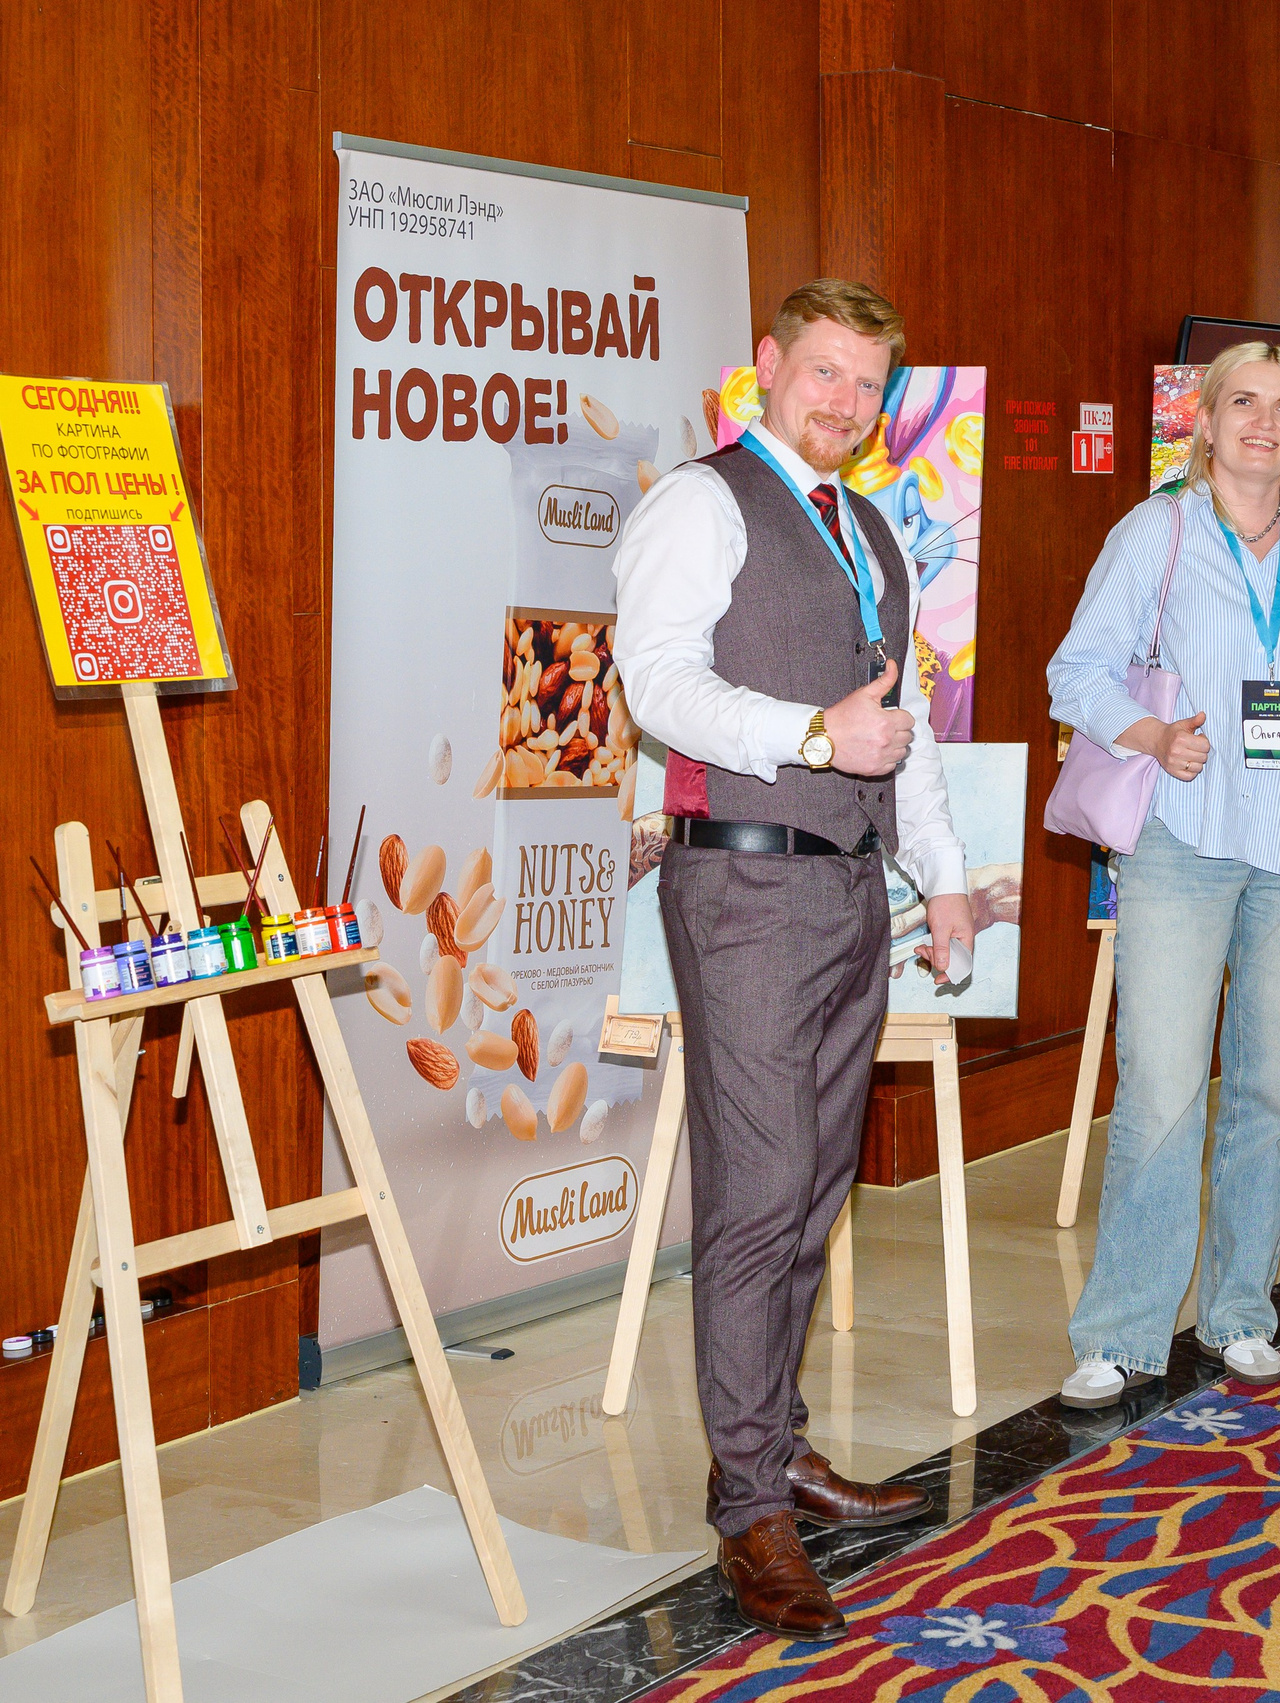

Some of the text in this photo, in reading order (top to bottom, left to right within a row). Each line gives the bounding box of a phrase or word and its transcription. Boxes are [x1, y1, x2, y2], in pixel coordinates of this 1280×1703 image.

[348, 178, 504, 223] ЗАО «Мюсли Лэнд»
[348, 205, 475, 240] УНП 192958741
[353, 266, 660, 361] ОТКРЫВАЙ
[21, 384, 141, 417] СЕГОДНЯ!!!
[352, 367, 568, 445] НОВОЕ!
[1006, 400, 1057, 416] ПРИ ПОЖАРЕ
[56, 422, 121, 439] КАРТИНА
[1013, 419, 1049, 434] ЗВОНИТЬ
[1083, 410, 1112, 426] ПК-22
[32, 443, 150, 462] ПО ФОТОГРАФИИ
[1024, 438, 1038, 452] 101
[1004, 456, 1058, 471] FIRE HYDRANT
[16, 469, 47, 495] ЗА
[51, 471, 101, 496] ПОЛ
[106, 472, 168, 500] ЦЕНЫ
[543, 496, 615, 533] Musli Land
[518, 842, 616, 899] NUTS&
[513, 897, 615, 954] HONEY
[537, 978, 560, 991] БЕЛОЙ
[560, 976, 594, 988] ГЛАЗУРЬЮ
[546, 964, 579, 977] МЕДОВЫЙ
[581, 962, 615, 974] БАТОНЧИК
[510, 1171, 628, 1244] Musli Land
